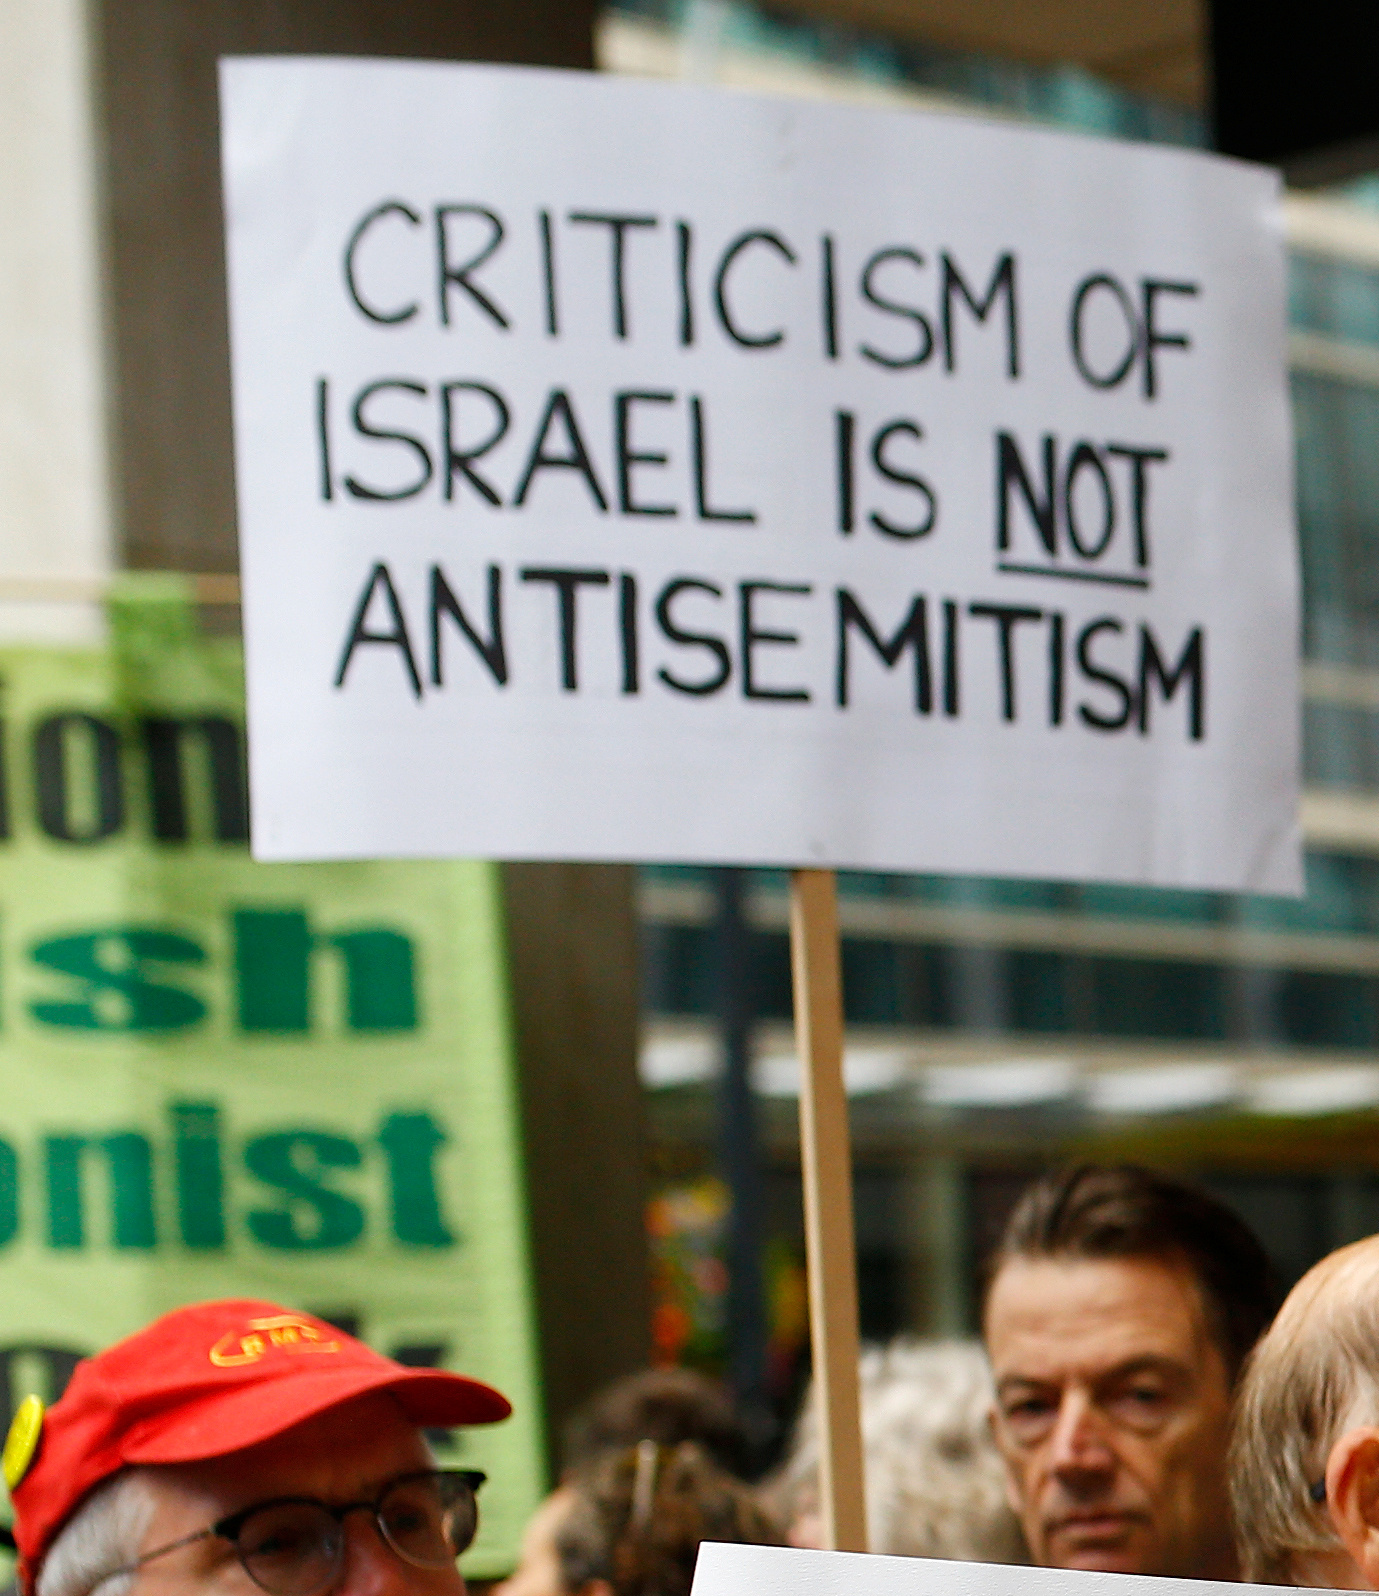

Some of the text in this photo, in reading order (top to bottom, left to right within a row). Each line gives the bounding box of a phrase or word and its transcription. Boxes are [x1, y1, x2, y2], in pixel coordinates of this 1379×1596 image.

[341, 200, 1201, 400] CRITICISM OF
[315, 377, 1170, 575] ISRAEL IS NOT
[332, 560, 1207, 744] ANTISEMITISM
[0, 668, 249, 846] on
[28, 902, 420, 1036] sh
[0, 1098, 456, 1253] nist
